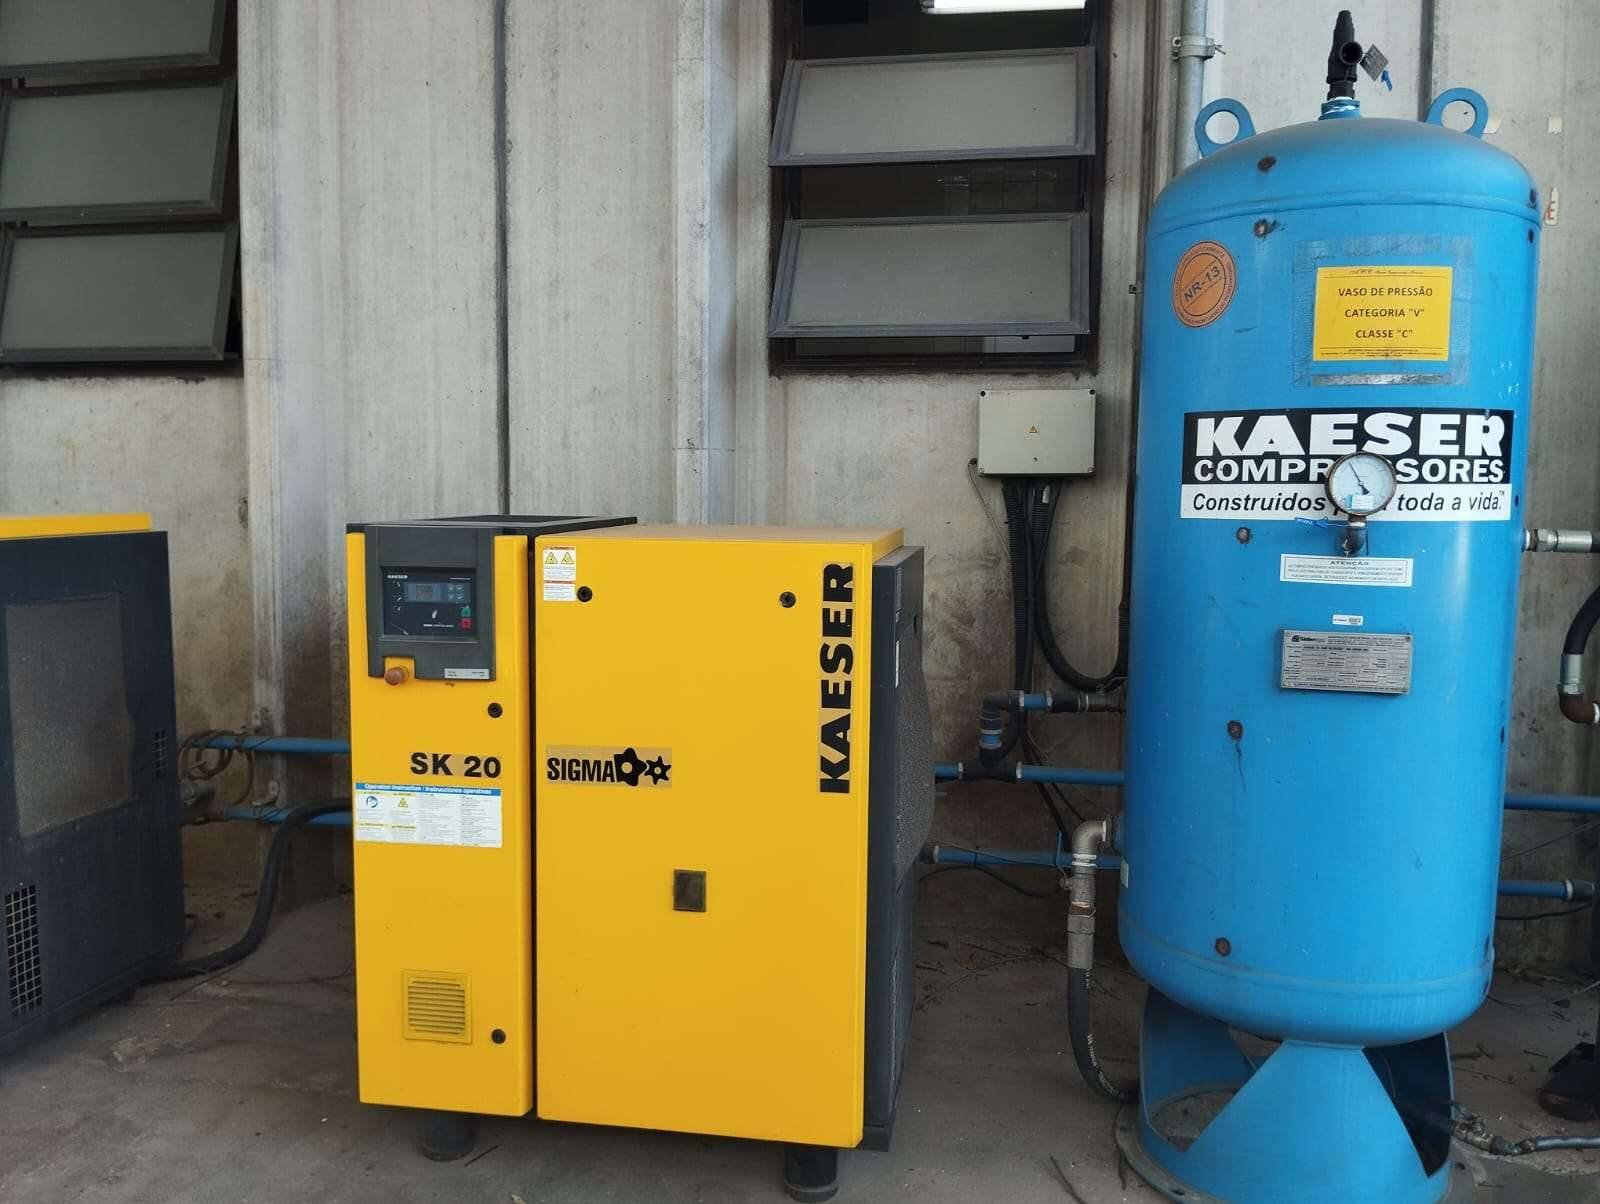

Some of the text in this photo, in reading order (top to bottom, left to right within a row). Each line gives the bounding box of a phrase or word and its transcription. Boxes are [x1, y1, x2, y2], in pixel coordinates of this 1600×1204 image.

[1184, 266, 1220, 302] NR-13
[1338, 286, 1433, 297] VASO DE PRESSÃO
[1345, 308, 1425, 318] CATEGORIA "V"
[1356, 329, 1413, 338] CLASSE "C"
[1196, 412, 1503, 457] KAESER
[1194, 458, 1504, 482] COMPRSORES
[1193, 492, 1326, 511] Construidos
[1397, 492, 1445, 511] toda
[1452, 497, 1461, 511] a
[820, 563, 854, 794] KAESER
[410, 752, 501, 778] SK 20
[547, 757, 615, 782] SIGMA
